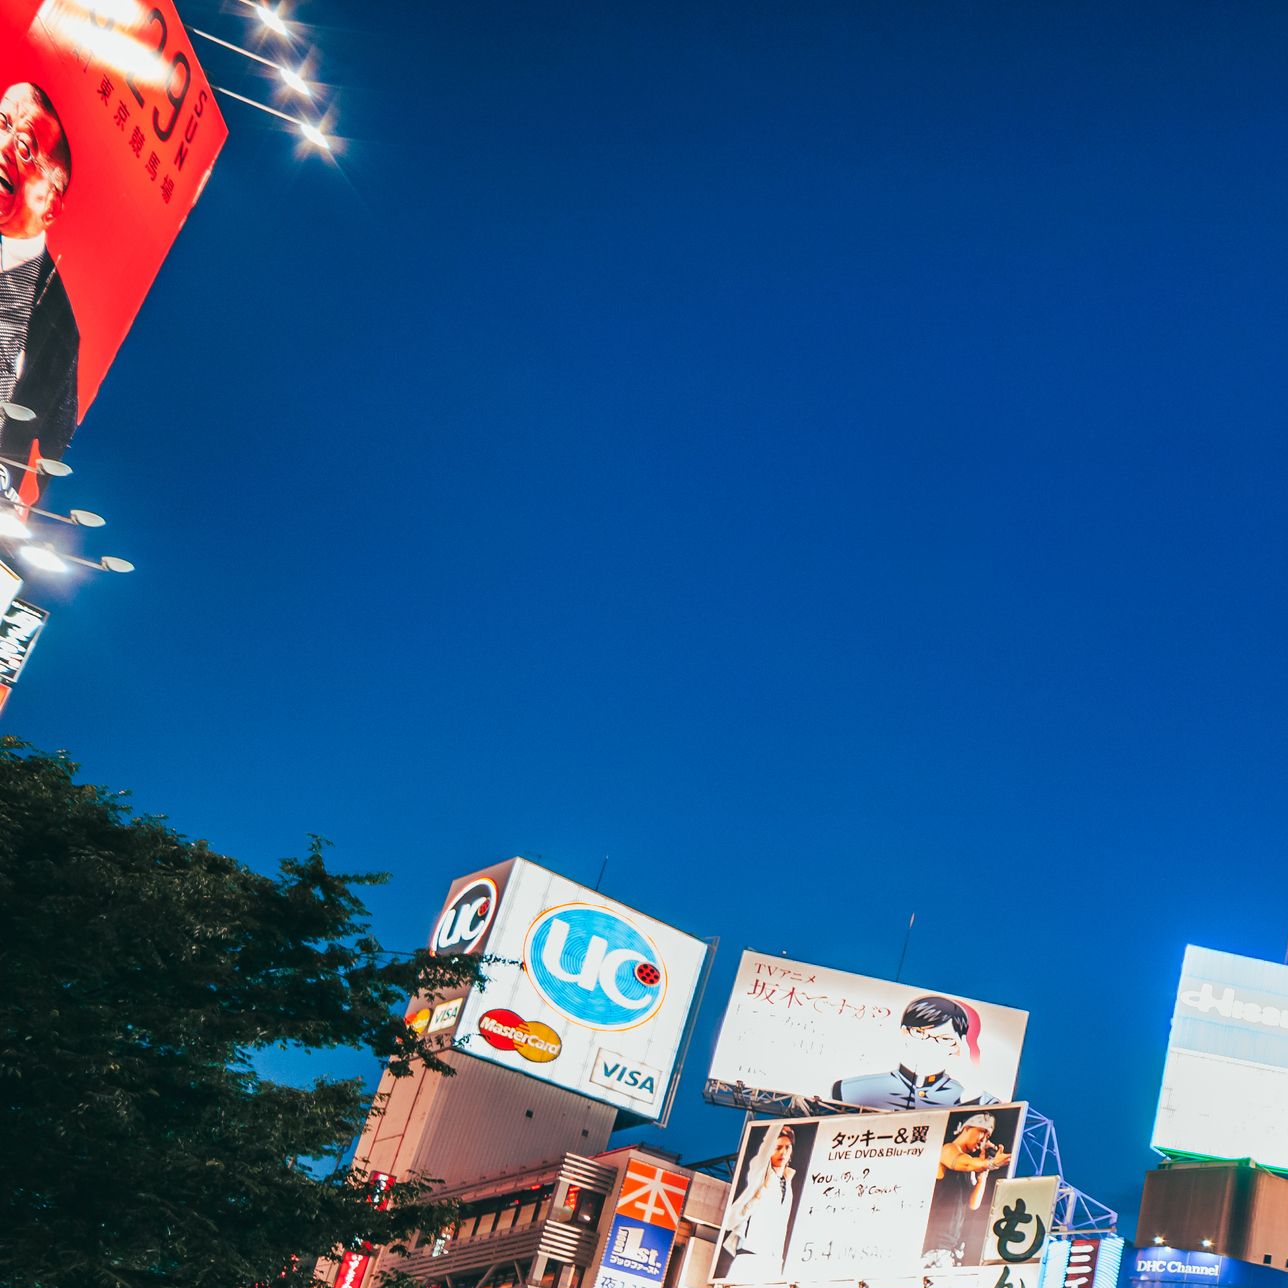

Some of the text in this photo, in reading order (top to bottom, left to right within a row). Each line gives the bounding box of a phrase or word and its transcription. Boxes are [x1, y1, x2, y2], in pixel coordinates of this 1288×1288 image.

[753, 962, 817, 984] TVアニメ
[480, 1016, 560, 1056] MasterCard
[602, 1060, 655, 1095] VISA
[831, 1125, 930, 1150] タッキー&翼
[828, 1146, 925, 1161] LIVE DVD&Blu-ray
[617, 1168, 687, 1225] 本
[610, 1255, 660, 1276] ブックファースト
[1136, 1259, 1220, 1278] DHC Channel
